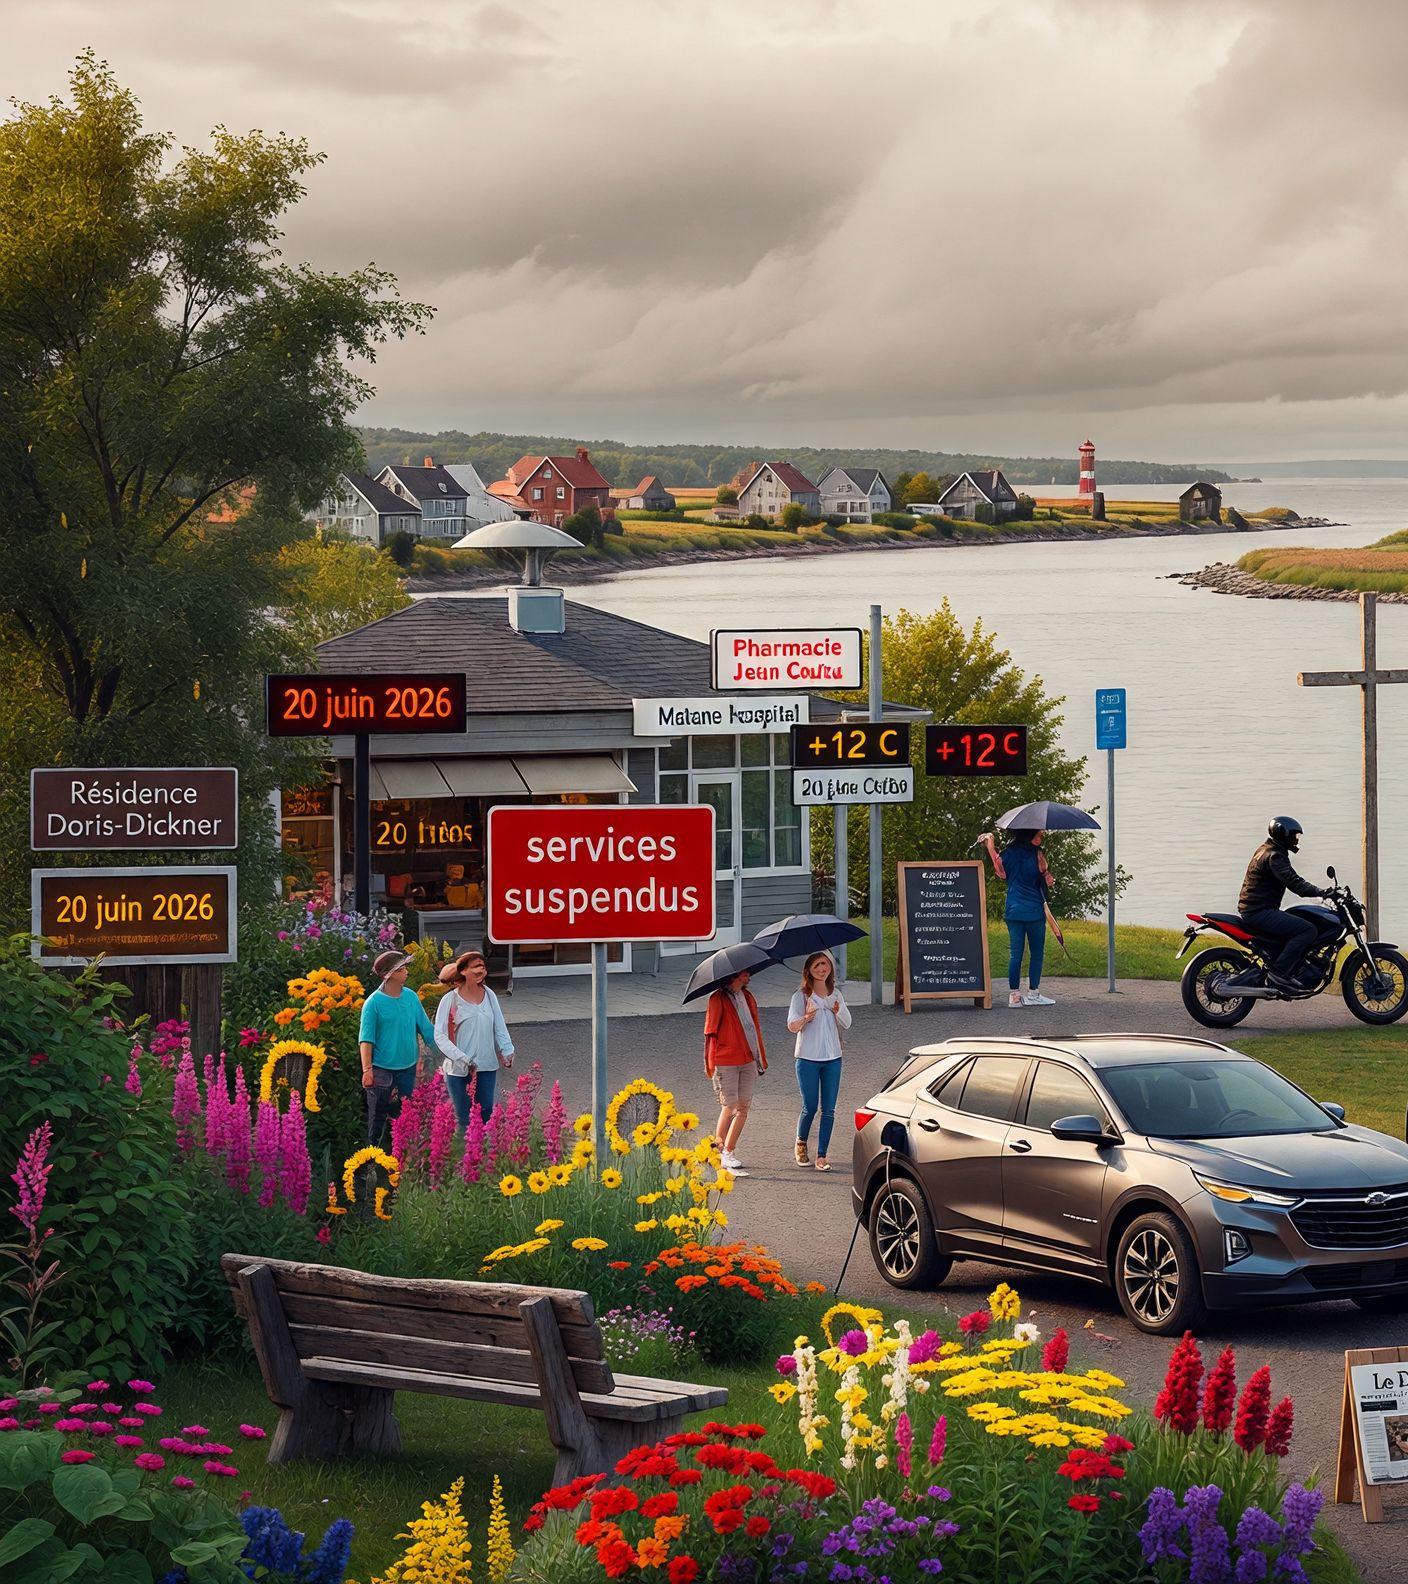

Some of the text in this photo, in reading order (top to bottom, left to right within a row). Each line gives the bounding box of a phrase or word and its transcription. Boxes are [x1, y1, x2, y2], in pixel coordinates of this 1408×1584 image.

[733, 638, 842, 657] Pharmacie
[283, 687, 452, 728] 20 juin 2026
[808, 729, 898, 760] +12 C
[71, 780, 198, 805] Résidence
[802, 778, 823, 796] 20
[47, 811, 222, 837] Doris-Dickner
[376, 821, 407, 845] 20
[526, 826, 677, 863] services
[56, 893, 214, 930] 20 juin 2026
[504, 876, 699, 925] suspendus
[1372, 1372, 1394, 1390] Le
